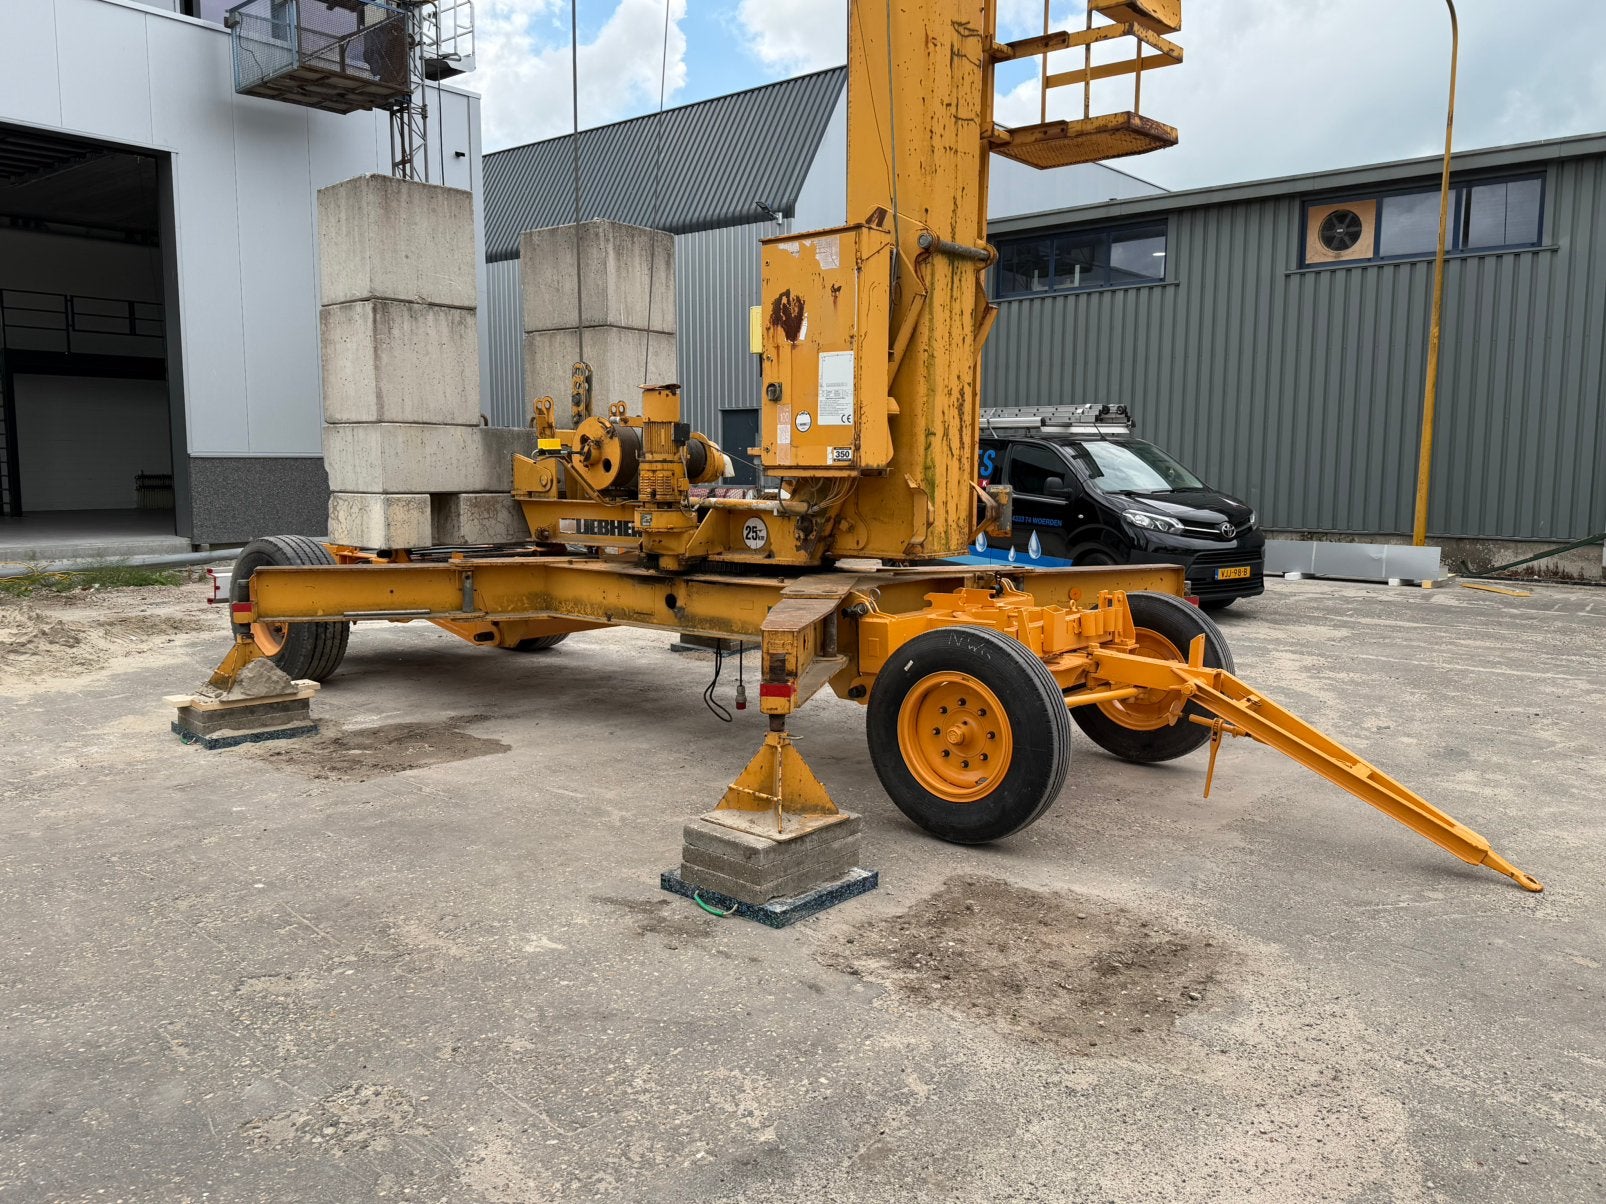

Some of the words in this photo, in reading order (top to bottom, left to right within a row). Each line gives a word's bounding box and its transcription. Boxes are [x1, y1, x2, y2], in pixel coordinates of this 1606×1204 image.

[835, 450, 850, 458] 350
[1032, 517, 1063, 527] WOERDEN
[745, 525, 757, 540] 25
[1220, 568, 1248, 578] VJJ-98-B
